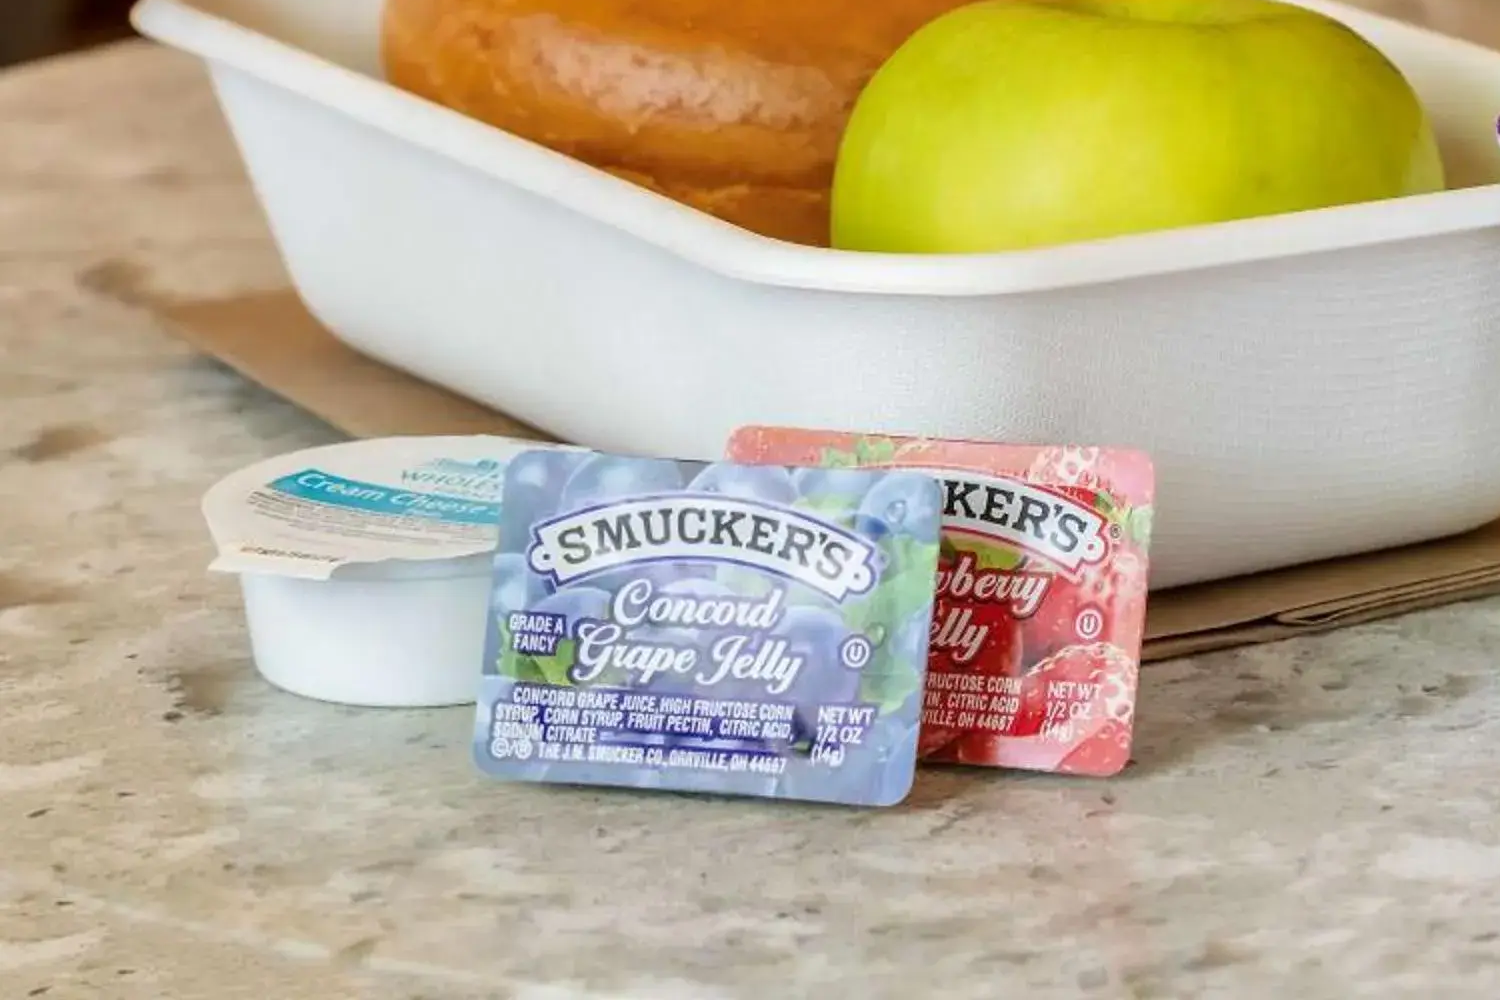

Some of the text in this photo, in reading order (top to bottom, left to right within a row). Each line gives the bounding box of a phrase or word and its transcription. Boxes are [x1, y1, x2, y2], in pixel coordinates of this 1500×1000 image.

[297, 473, 386, 502] Cream
[390, 492, 488, 514] Cheese
[942, 479, 1088, 553] KER'S
[557, 507, 853, 581] SMUCKER'S
[614, 578, 783, 628] Concord
[509, 613, 564, 635] GRADE A
[929, 608, 988, 662] elly
[513, 633, 557, 653] FANCY
[572, 623, 803, 694] Grape Jelly
[926, 674, 1022, 695] RUCTOSE CORN
[1048, 680, 1103, 700] NET WT
[513, 687, 575, 706] CONCORD
[578, 691, 618, 710] GRAPE
[660, 698, 691, 715] HIGH
[693, 700, 756, 719] FRUCTOSE
[759, 703, 795, 721] CORN
[949, 693, 987, 711] CITRIC
[989, 696, 1019, 714] ACID
[1045, 701, 1093, 720] 1/2 OZ
[543, 708, 580, 726] CORN
[627, 710, 665, 730] FRUIT
[719, 719, 761, 738] CITRIC
[817, 706, 875, 725] NET WT
[493, 721, 597, 743] SODIUM CITRATE
[815, 725, 863, 744] 1/2 OZ
[588, 745, 643, 764] SMUCKER
[809, 743, 846, 768] (14g)
